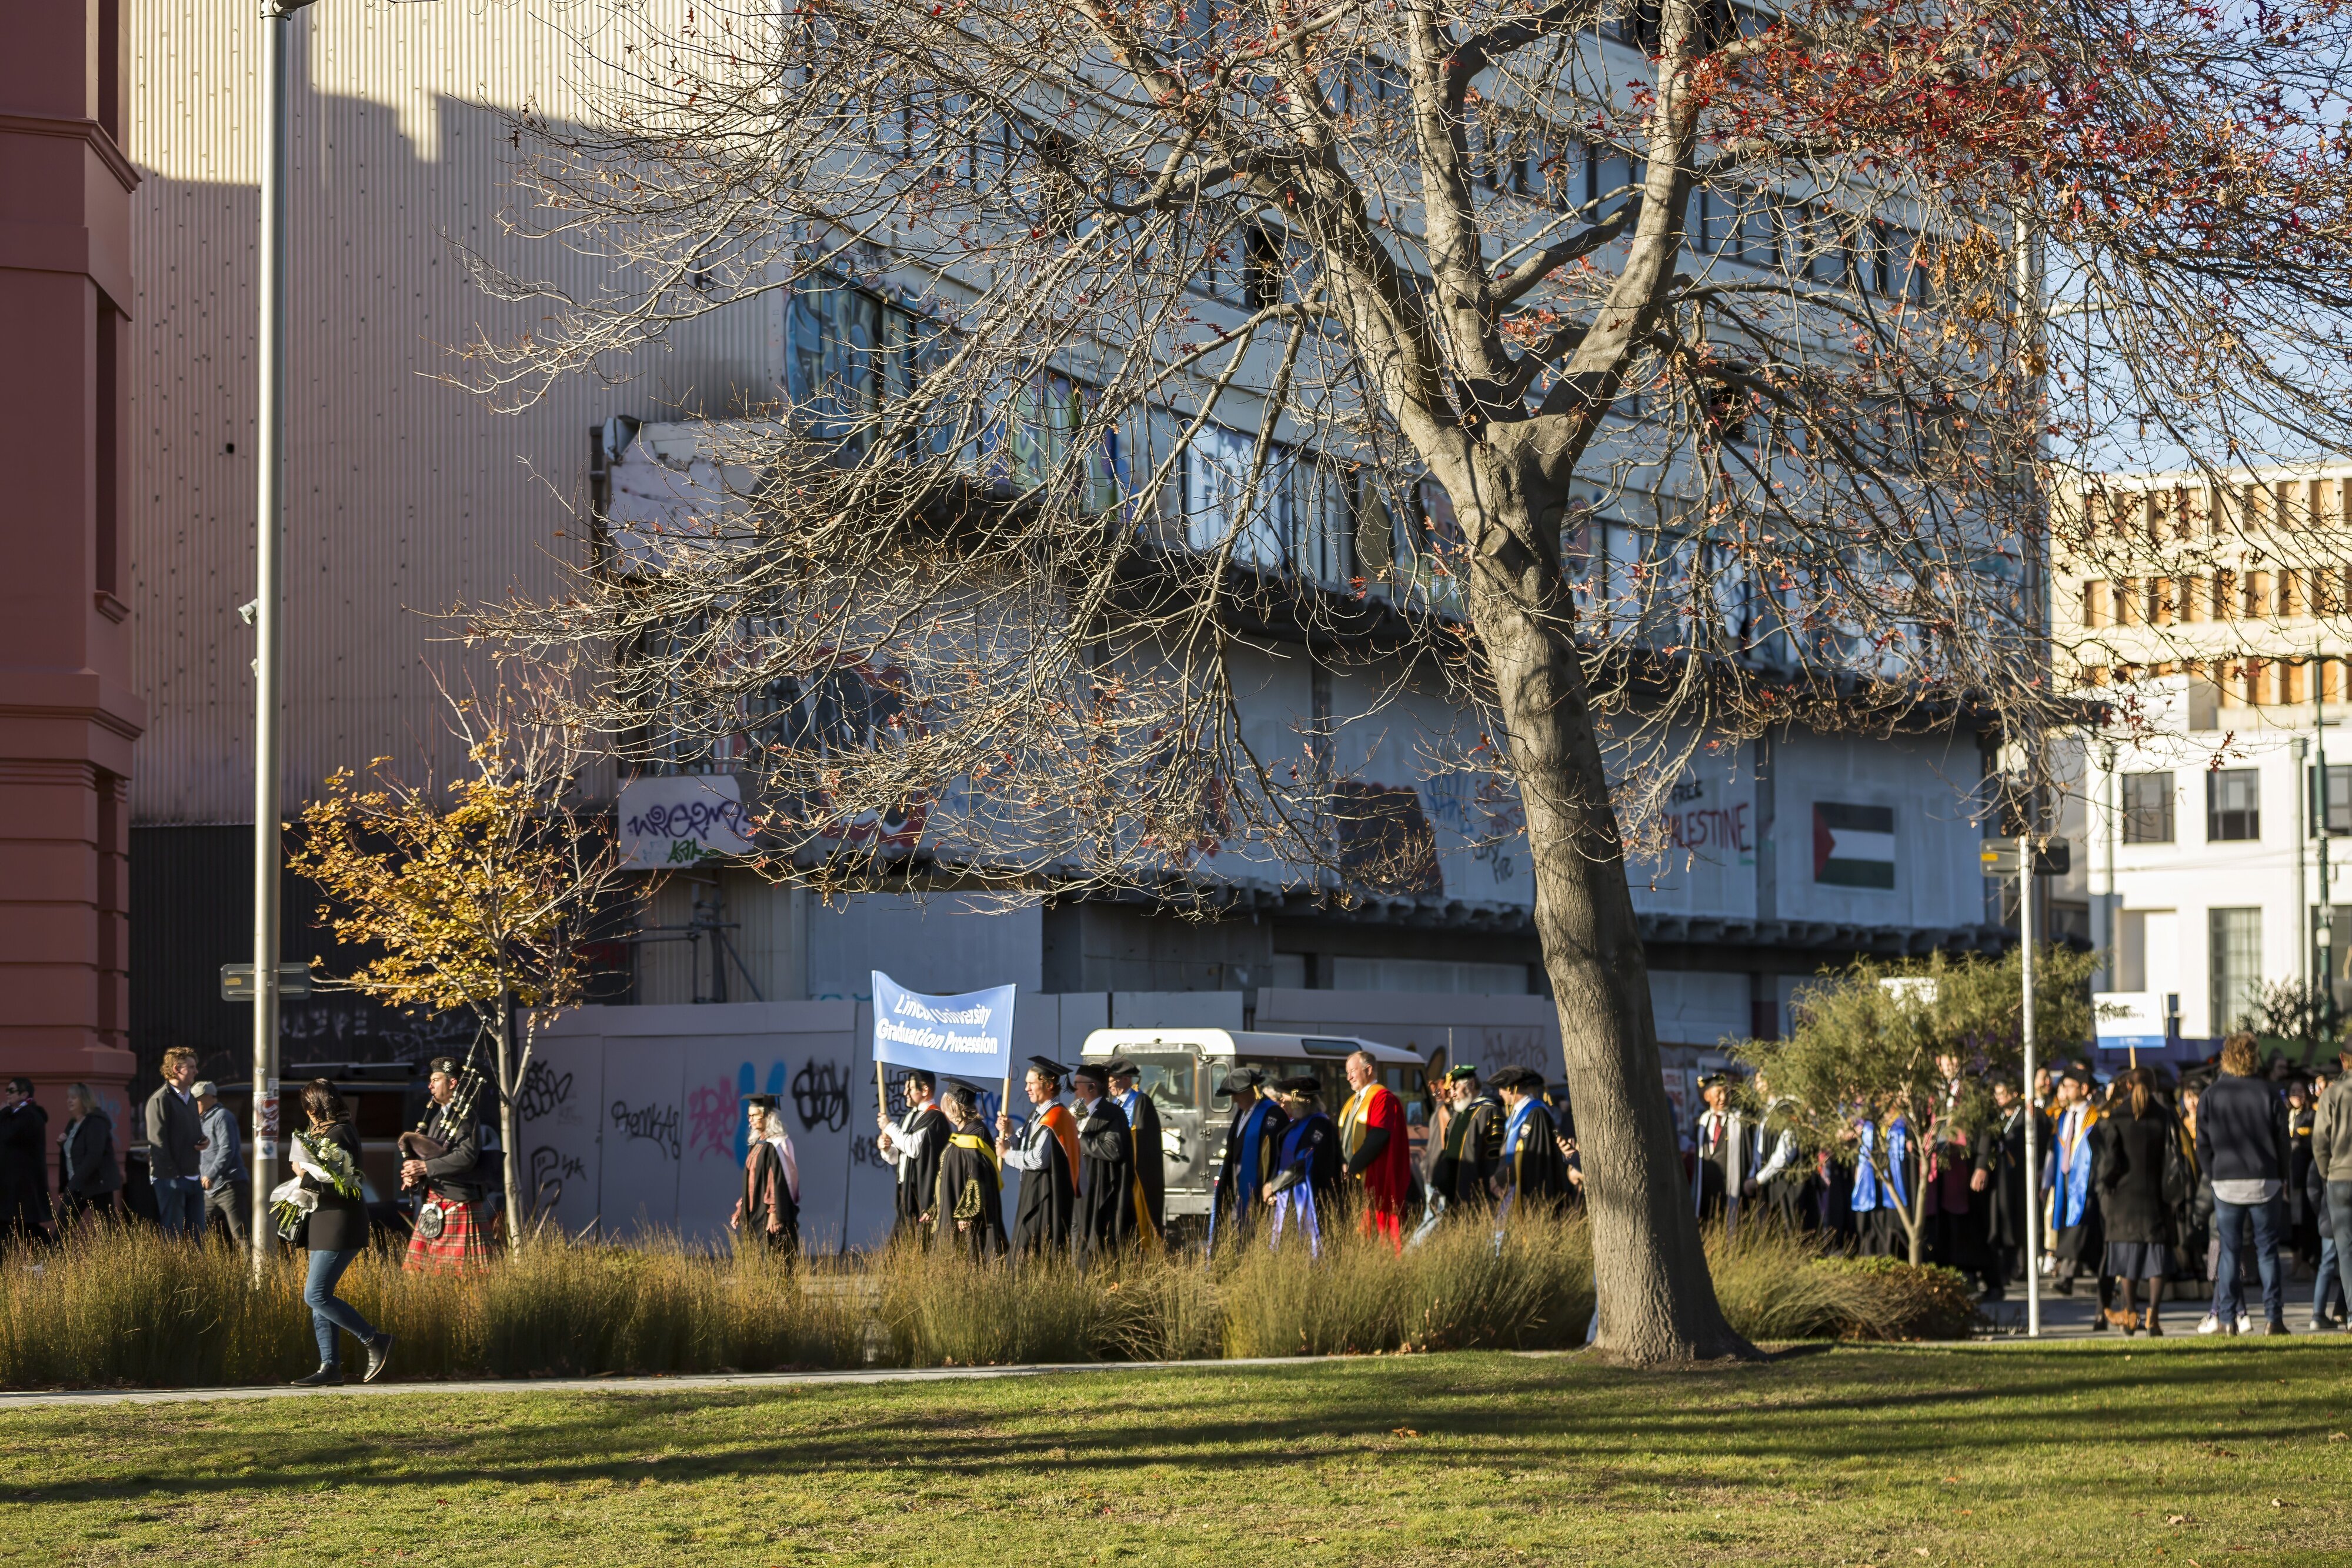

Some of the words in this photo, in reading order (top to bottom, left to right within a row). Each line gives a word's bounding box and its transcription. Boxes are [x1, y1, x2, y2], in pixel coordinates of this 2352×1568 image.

[893, 993, 938, 1024] Lincol
[931, 1003, 992, 1029] University
[876, 1017, 945, 1050] Graduation
[942, 1030, 998, 1055] Procession
